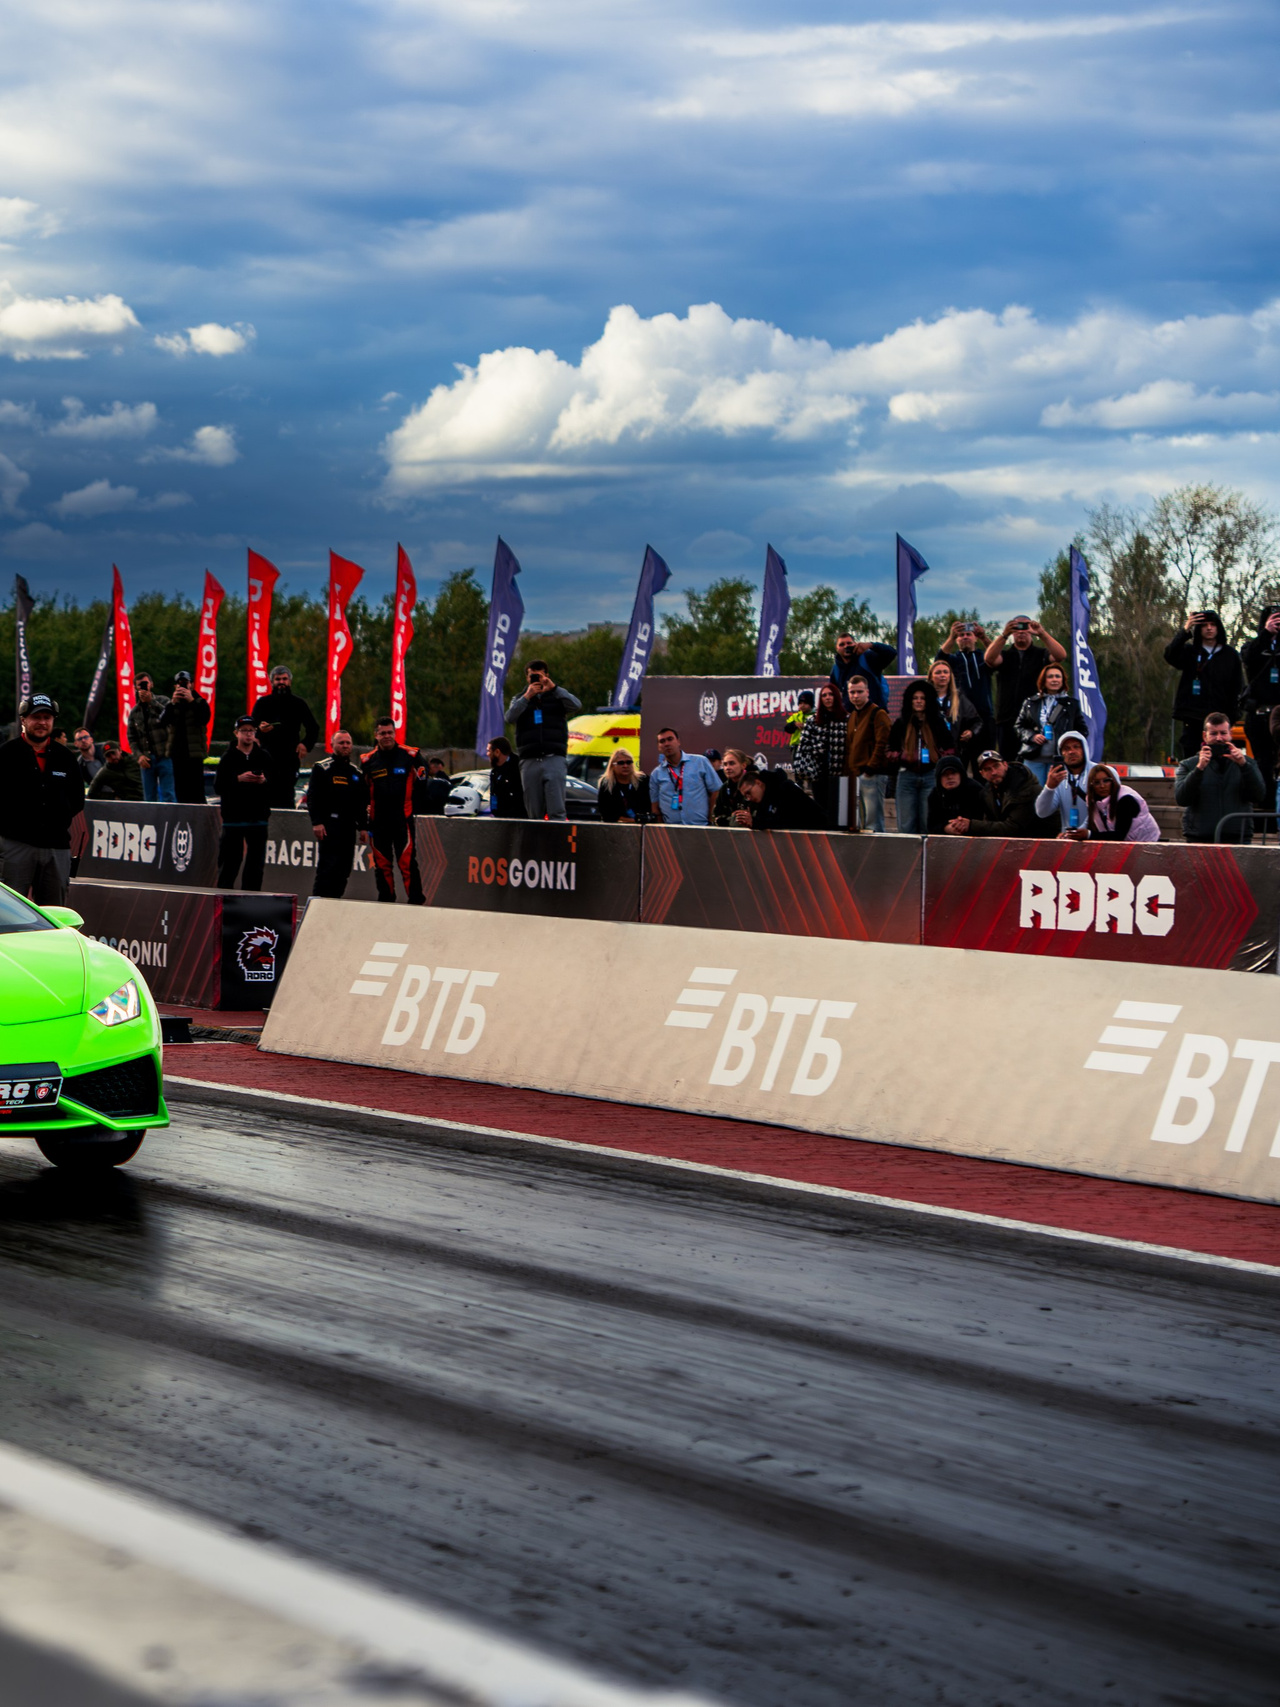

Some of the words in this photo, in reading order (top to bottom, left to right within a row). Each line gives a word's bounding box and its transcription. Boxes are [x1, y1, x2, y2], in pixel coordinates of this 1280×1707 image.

[200, 598, 216, 703] uto.ru
[492, 613, 511, 670] ВТБ
[629, 622, 651, 681] ВТБ
[727, 688, 821, 718] СУПЕРКУ
[92, 819, 157, 864] RDRC
[265, 840, 367, 872] RACEK
[468, 856, 576, 891] ROSGONKI
[1019, 869, 1176, 937] RDRC
[89, 935, 167, 968] SGONKI
[246, 972, 274, 980] RDRC
[381, 964, 499, 1055] ВТБ
[708, 993, 857, 1097] ВТБ
[1150, 1033, 1280, 1158] ВТ
